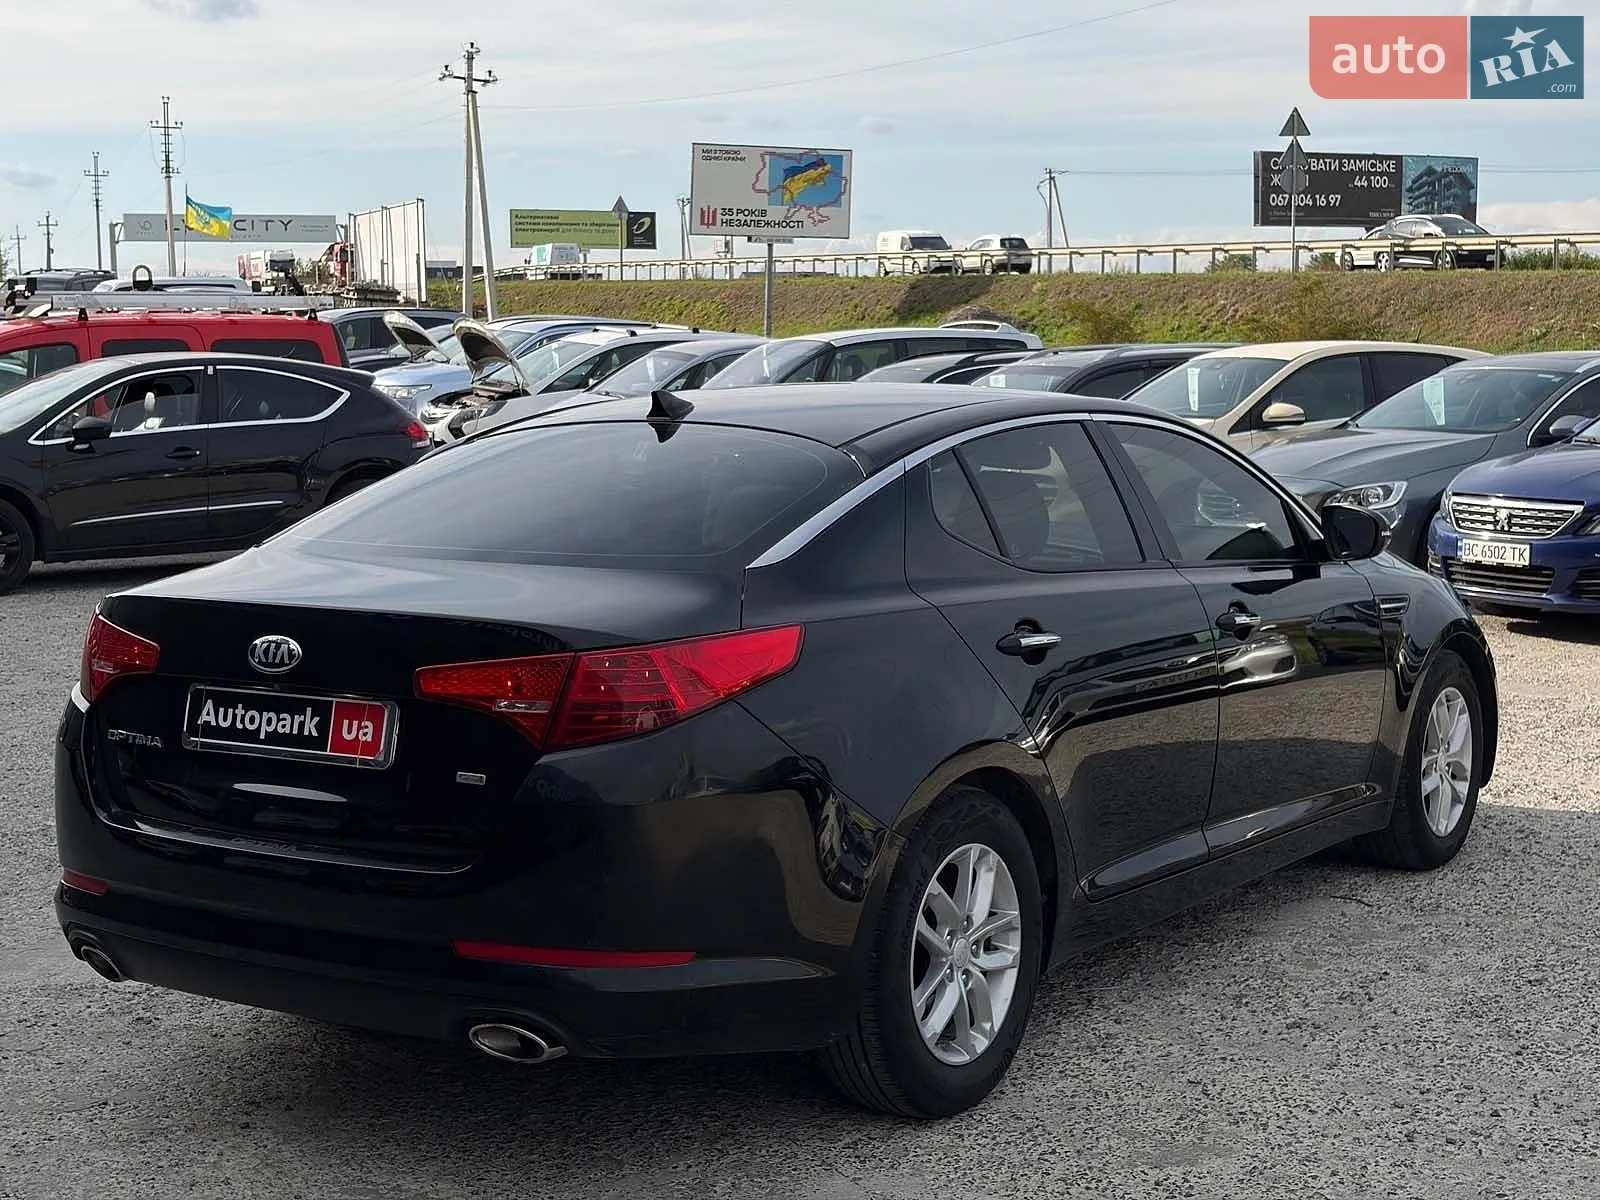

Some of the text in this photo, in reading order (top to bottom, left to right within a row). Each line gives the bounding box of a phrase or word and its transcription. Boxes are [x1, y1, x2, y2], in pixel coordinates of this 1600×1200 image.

[1342, 160, 1396, 172] ЗАМІСЬКЕ
[1354, 176, 1368, 188] 44
[1370, 176, 1389, 188] 100
[1270, 194, 1289, 206] 067
[1315, 194, 1326, 207] 16
[1328, 195, 1341, 207] 97
[721, 208, 767, 218] 35 РОКІВ
[721, 218, 804, 229] НЕЗАЛЕЖНОСТІ
[1464, 543, 1527, 562] BC 6502 TK
[254, 643, 290, 664] KIA
[197, 699, 373, 743] Autopark ua
[108, 729, 162, 748] OPTIMA
